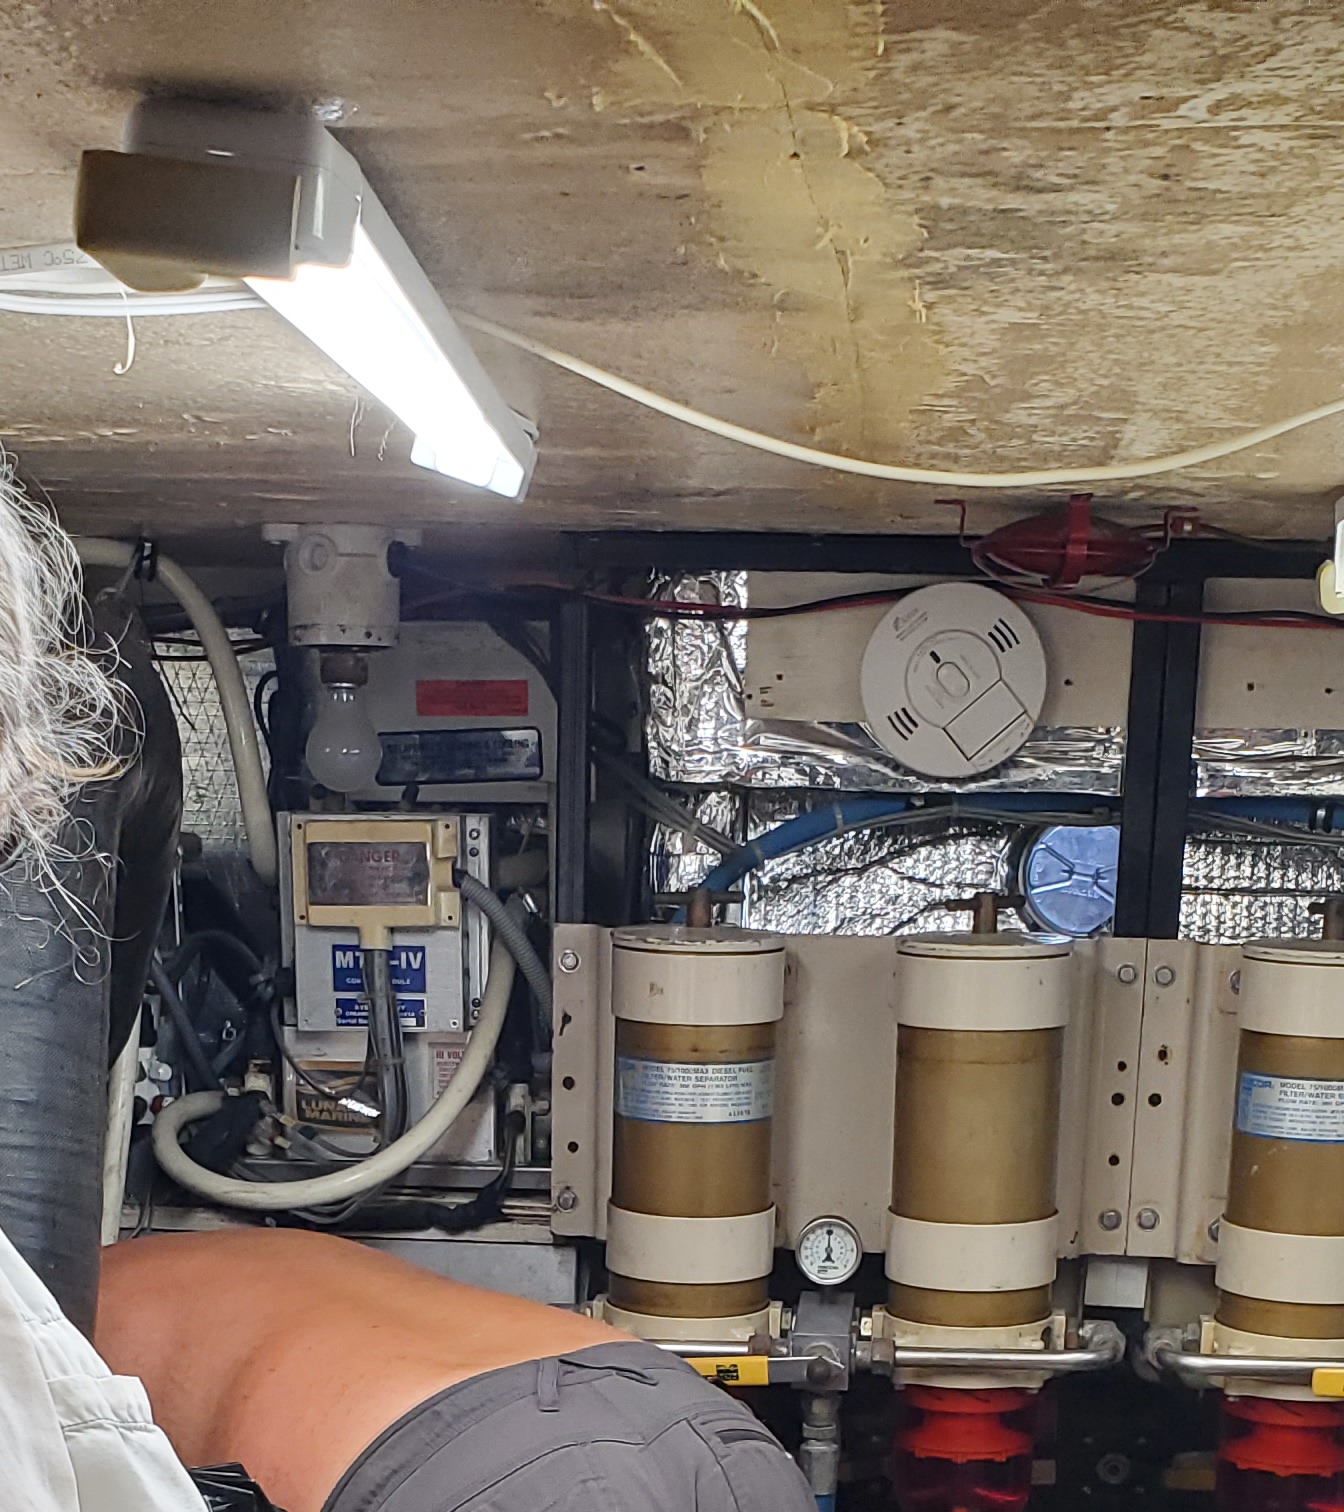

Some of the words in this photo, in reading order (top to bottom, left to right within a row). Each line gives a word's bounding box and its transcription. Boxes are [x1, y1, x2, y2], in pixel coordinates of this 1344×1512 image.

[0, 253, 32, 272] WET
[335, 950, 423, 971] MT-IV
[1279, 1081, 1306, 1090] MODEL
